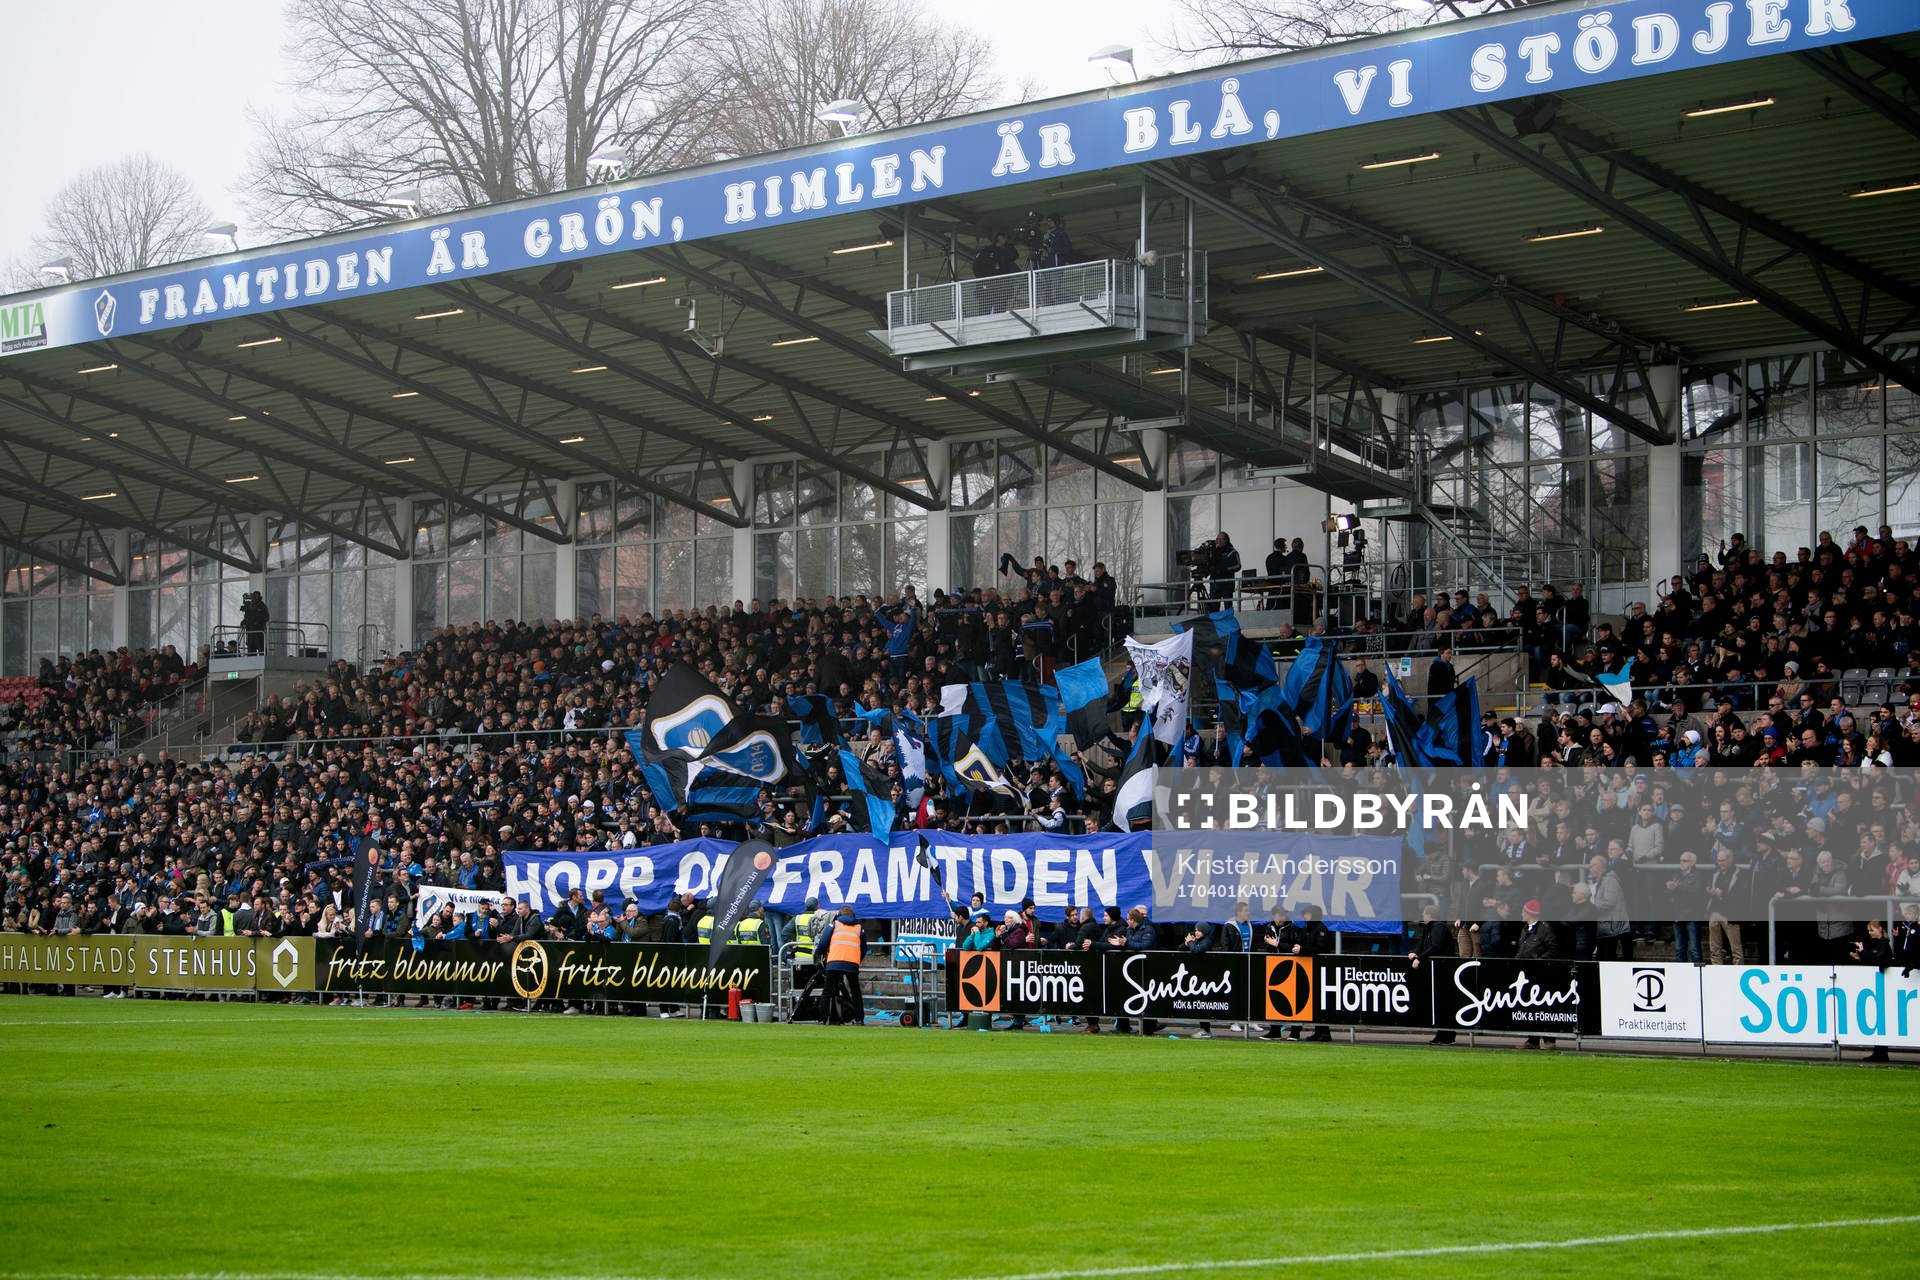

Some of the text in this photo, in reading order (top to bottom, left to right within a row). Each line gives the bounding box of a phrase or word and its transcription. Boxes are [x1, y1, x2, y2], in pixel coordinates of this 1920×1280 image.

[139, 0, 1856, 325] FRAMTIDEN ÄR GRÖN, HIMLEN ÄR BLÅ, VI STÖDJER
[0, 303, 47, 339] MTA
[505, 856, 654, 912] HOPP
[769, 848, 1117, 906] FRAMTIDEN
[1141, 848, 1213, 907] VI
[1237, 850, 1376, 918] HAR
[717, 871, 758, 930] Fastighetsbyrån
[2, 947, 136, 973] HALMSTADS
[149, 948, 256, 976] STENHUS
[325, 946, 388, 991] fritz
[394, 951, 504, 983] blommor
[555, 953, 626, 999] fritz
[631, 953, 759, 990] blommor
[1006, 960, 1084, 1003] Home
[1027, 961, 1081, 976] Electrolux
[1344, 967, 1407, 983] Electrolux
[1123, 953, 1232, 1015] Sentens
[1173, 1000, 1229, 1011] KÖK & FÖRVARING
[1320, 966, 1410, 1012] Home
[1454, 961, 1580, 1027] Sentens
[1739, 968, 1918, 1036] Söndr
[1512, 1010, 1578, 1023] KÖK & FÖRVARING
[1618, 1018, 1687, 1033] Praktikertjänst
